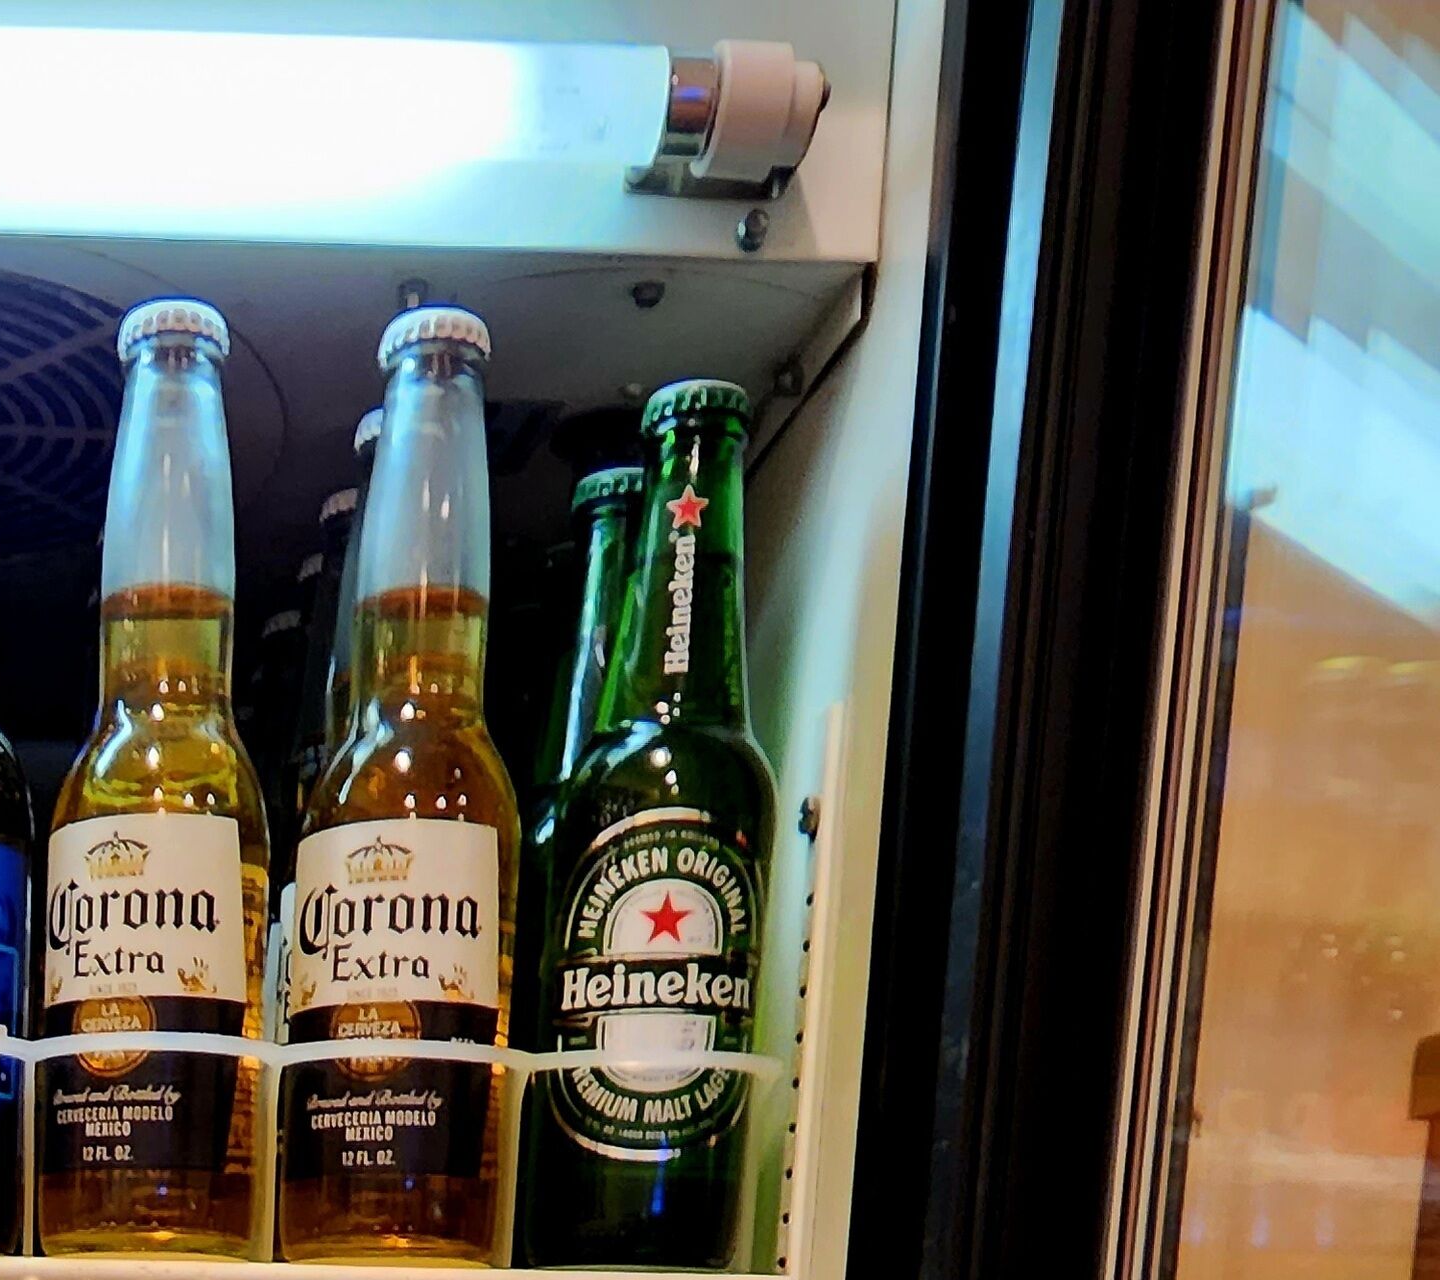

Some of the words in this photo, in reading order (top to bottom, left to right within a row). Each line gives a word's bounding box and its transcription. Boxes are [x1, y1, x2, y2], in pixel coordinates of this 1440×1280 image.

[664, 533, 696, 674] Heineken
[577, 846, 668, 939] HEINEKEN
[675, 847, 747, 935] ORIGINAL
[49, 879, 221, 955] Corona
[299, 884, 482, 959] Corona
[73, 937, 166, 979] Extra
[331, 943, 431, 983] Extra
[560, 963, 751, 1012] Heineken
[81, 1014, 142, 1033] CERVEZA
[100, 1003, 120, 1017] LA
[359, 1007, 379, 1021] LA
[337, 1020, 402, 1038] CERVEZA
[572, 1066, 638, 1123] REMIUM
[643, 1098, 693, 1124] MALT
[57, 1105, 119, 1125] CERVECERIA
[122, 1105, 174, 1122] MODELO
[85, 1121, 132, 1137] MEXICO
[311, 1111, 382, 1130] CERVECERIA
[384, 1110, 436, 1127] MODELO
[345, 1125, 394, 1142] MEXICO
